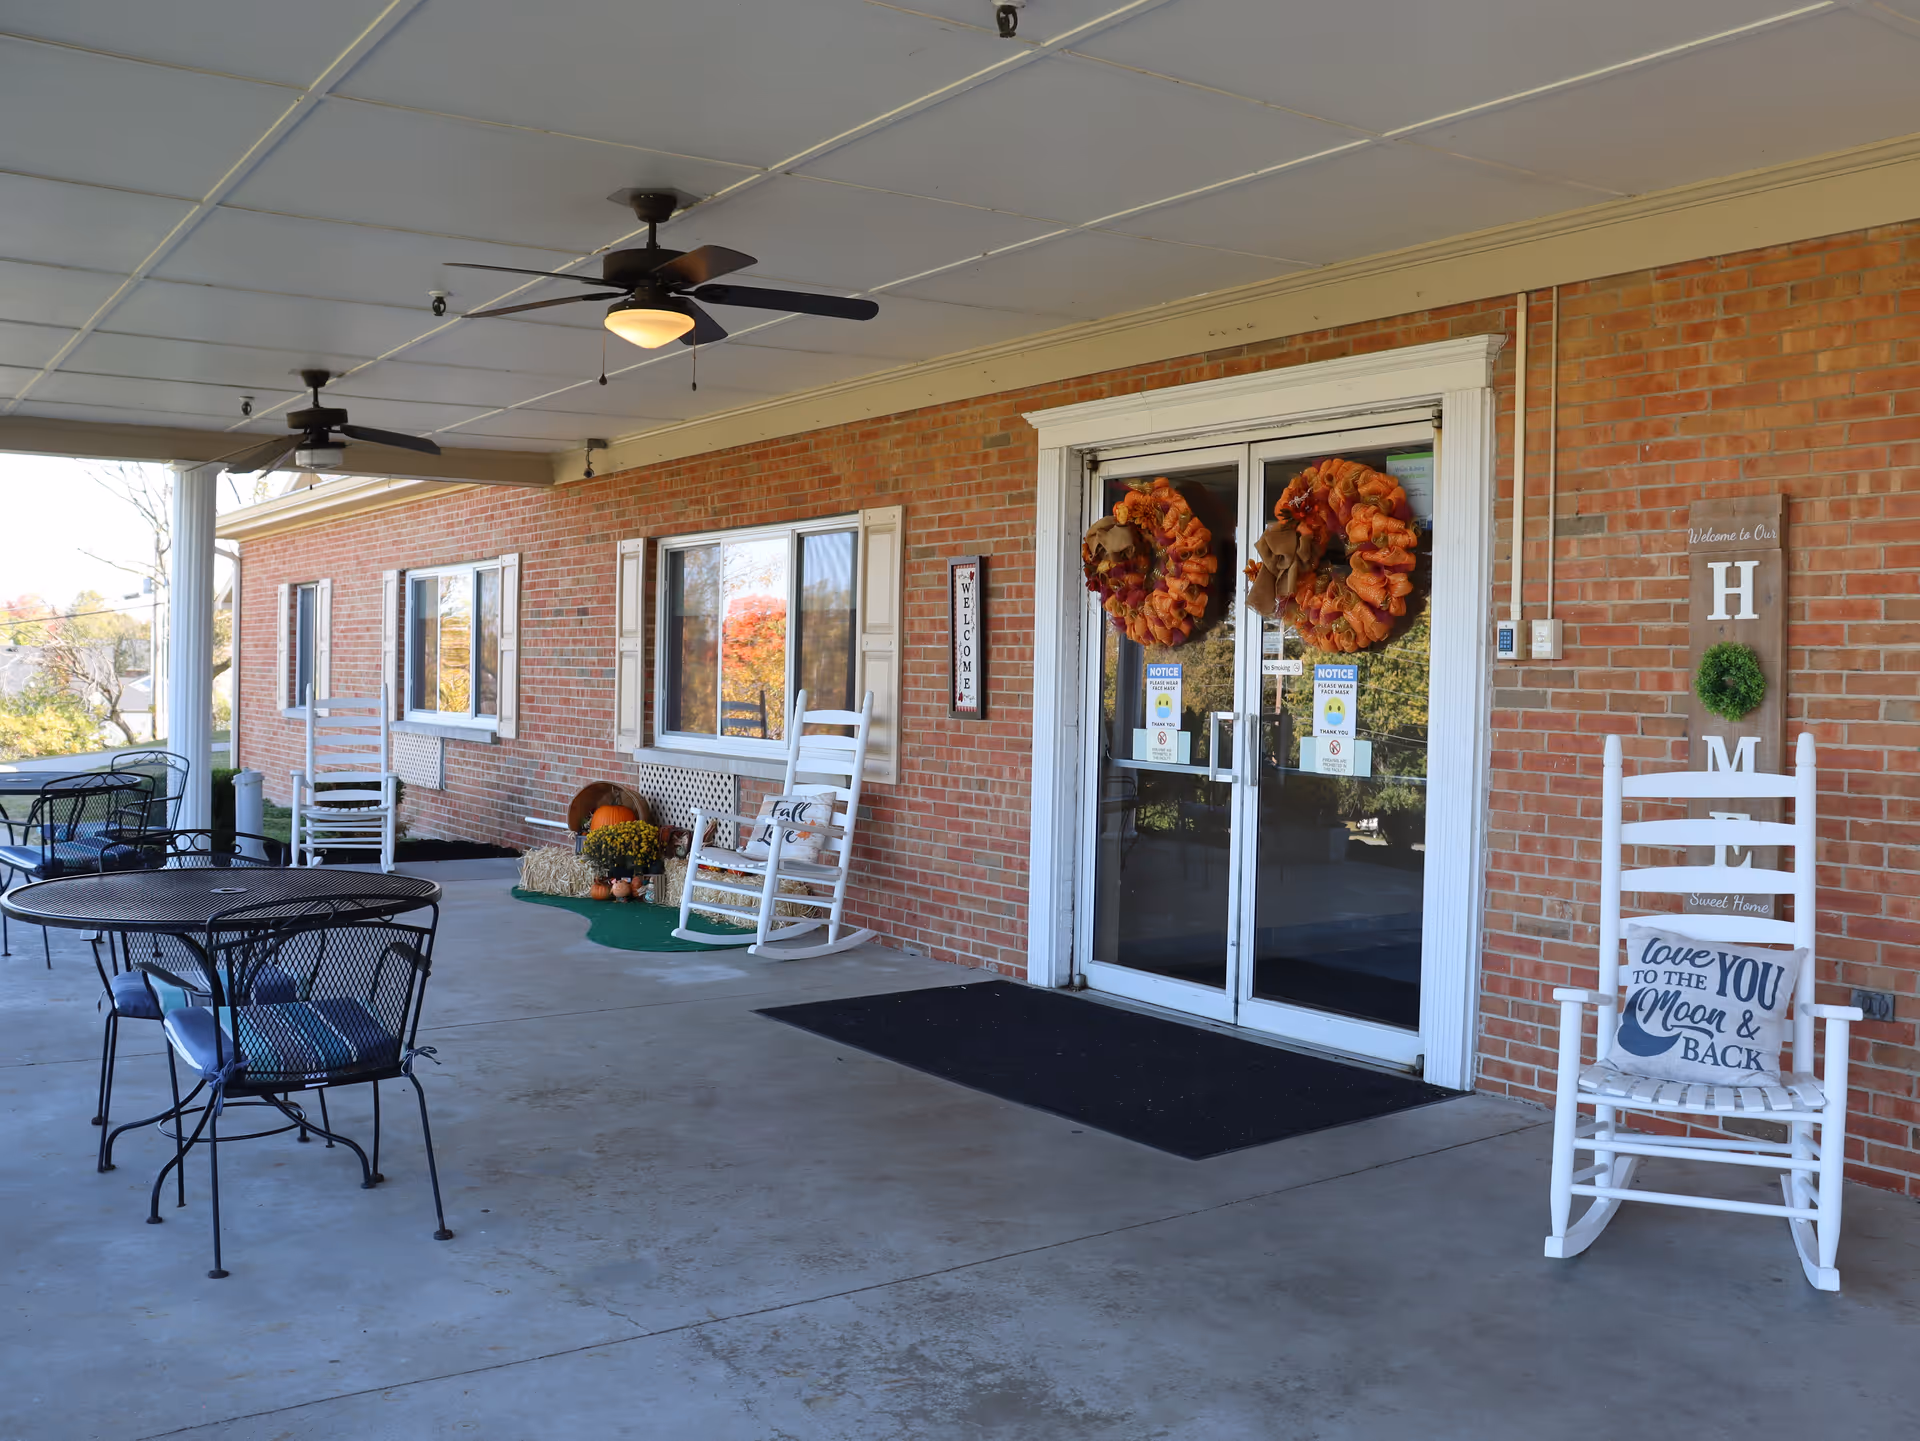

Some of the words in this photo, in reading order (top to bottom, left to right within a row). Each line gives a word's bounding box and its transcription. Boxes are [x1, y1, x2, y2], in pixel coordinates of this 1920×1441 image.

[1688, 527, 1736, 544] Welcome
[1740, 528, 1751, 540] to
[1754, 524, 1777, 540] Our
[961, 583, 972, 690] WELCOME
[1150, 667, 1179, 677] NOTICE
[1271, 664, 1291, 672] Smoking
[1318, 668, 1354, 679] NOTICE
[770, 800, 812, 822] Fall
[1690, 892, 1728, 909] Sweet
[1733, 894, 1769, 913] Home
[1632, 969, 1658, 985] TO
[1664, 970, 1708, 991] THE
[1716, 952, 1785, 1011] YOU
[1637, 987, 1727, 1036] Moon
[1736, 1009, 1761, 1040] &
[1680, 1036, 1765, 1072] BACK
